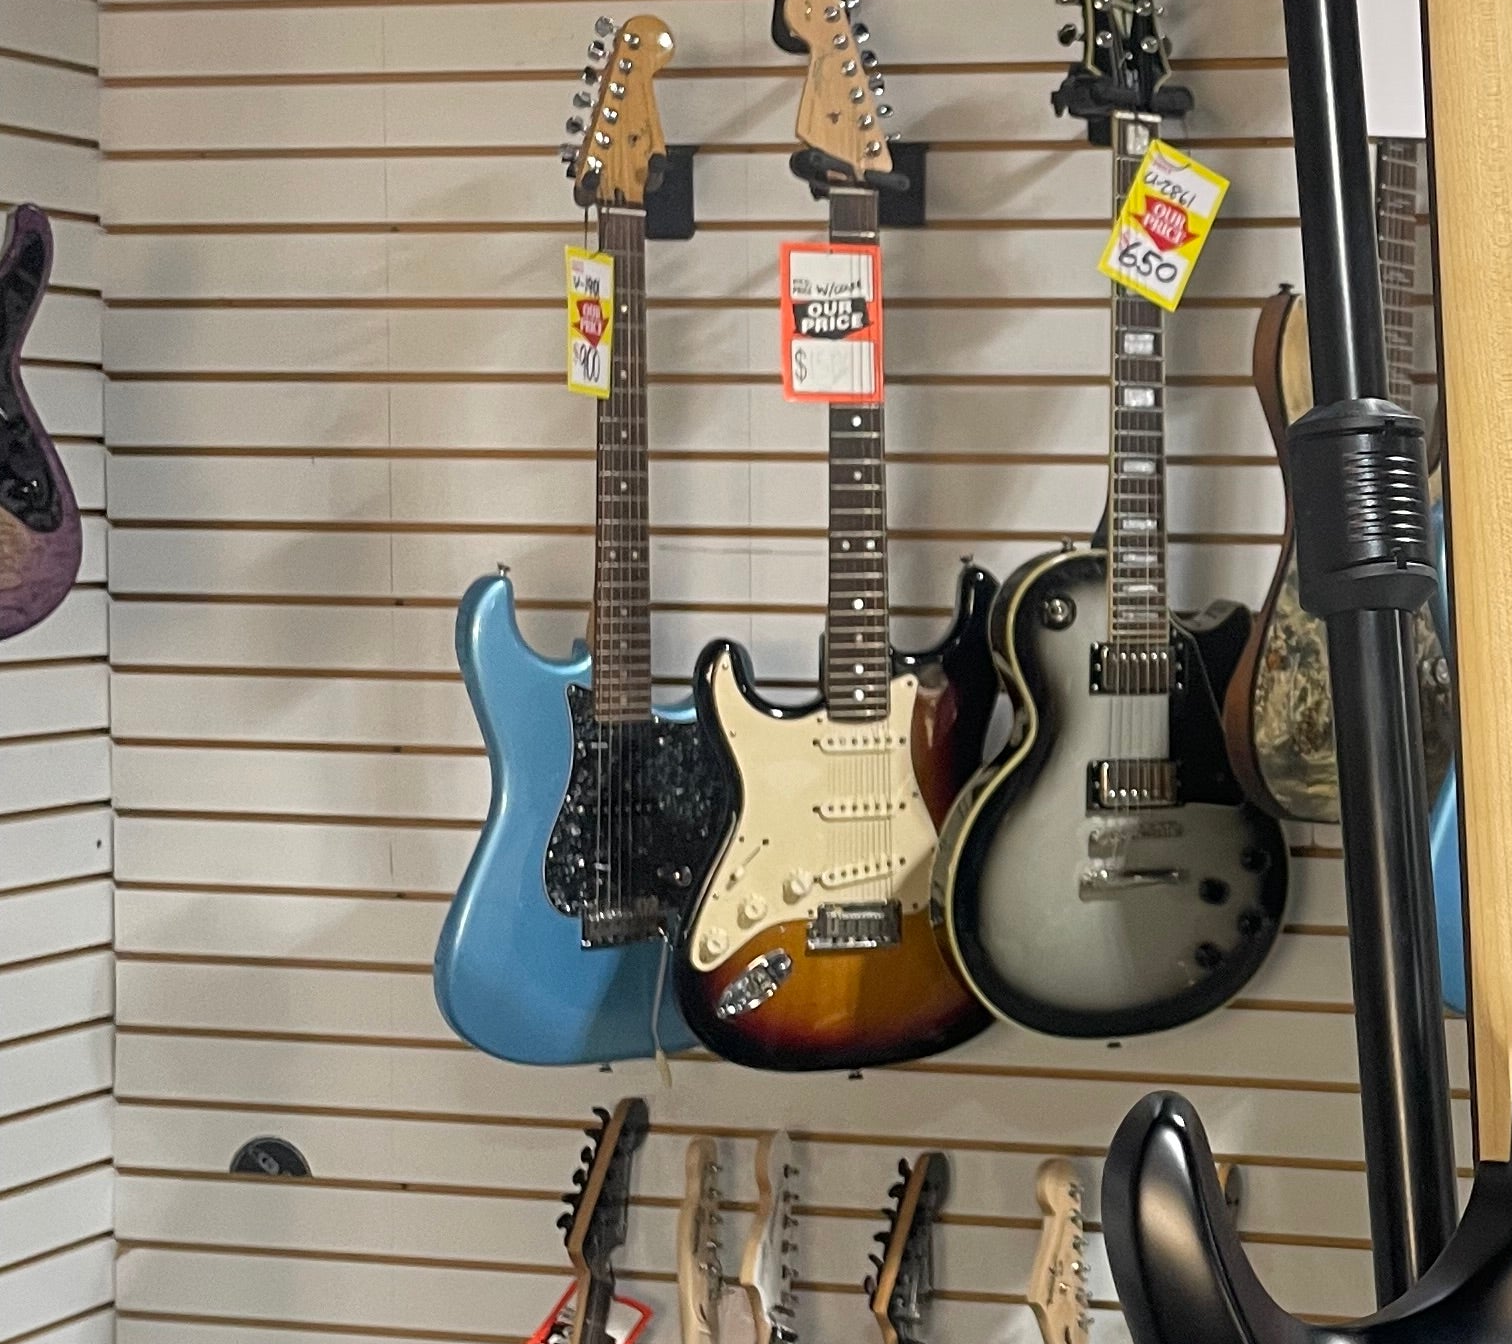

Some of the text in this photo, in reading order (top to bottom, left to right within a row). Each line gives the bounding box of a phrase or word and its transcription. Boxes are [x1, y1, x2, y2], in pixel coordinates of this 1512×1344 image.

[1142, 212, 1187, 244] PRICE
[1153, 202, 1187, 229] OUR
[807, 299, 853, 318] OUR
[801, 312, 864, 335] PRICE
